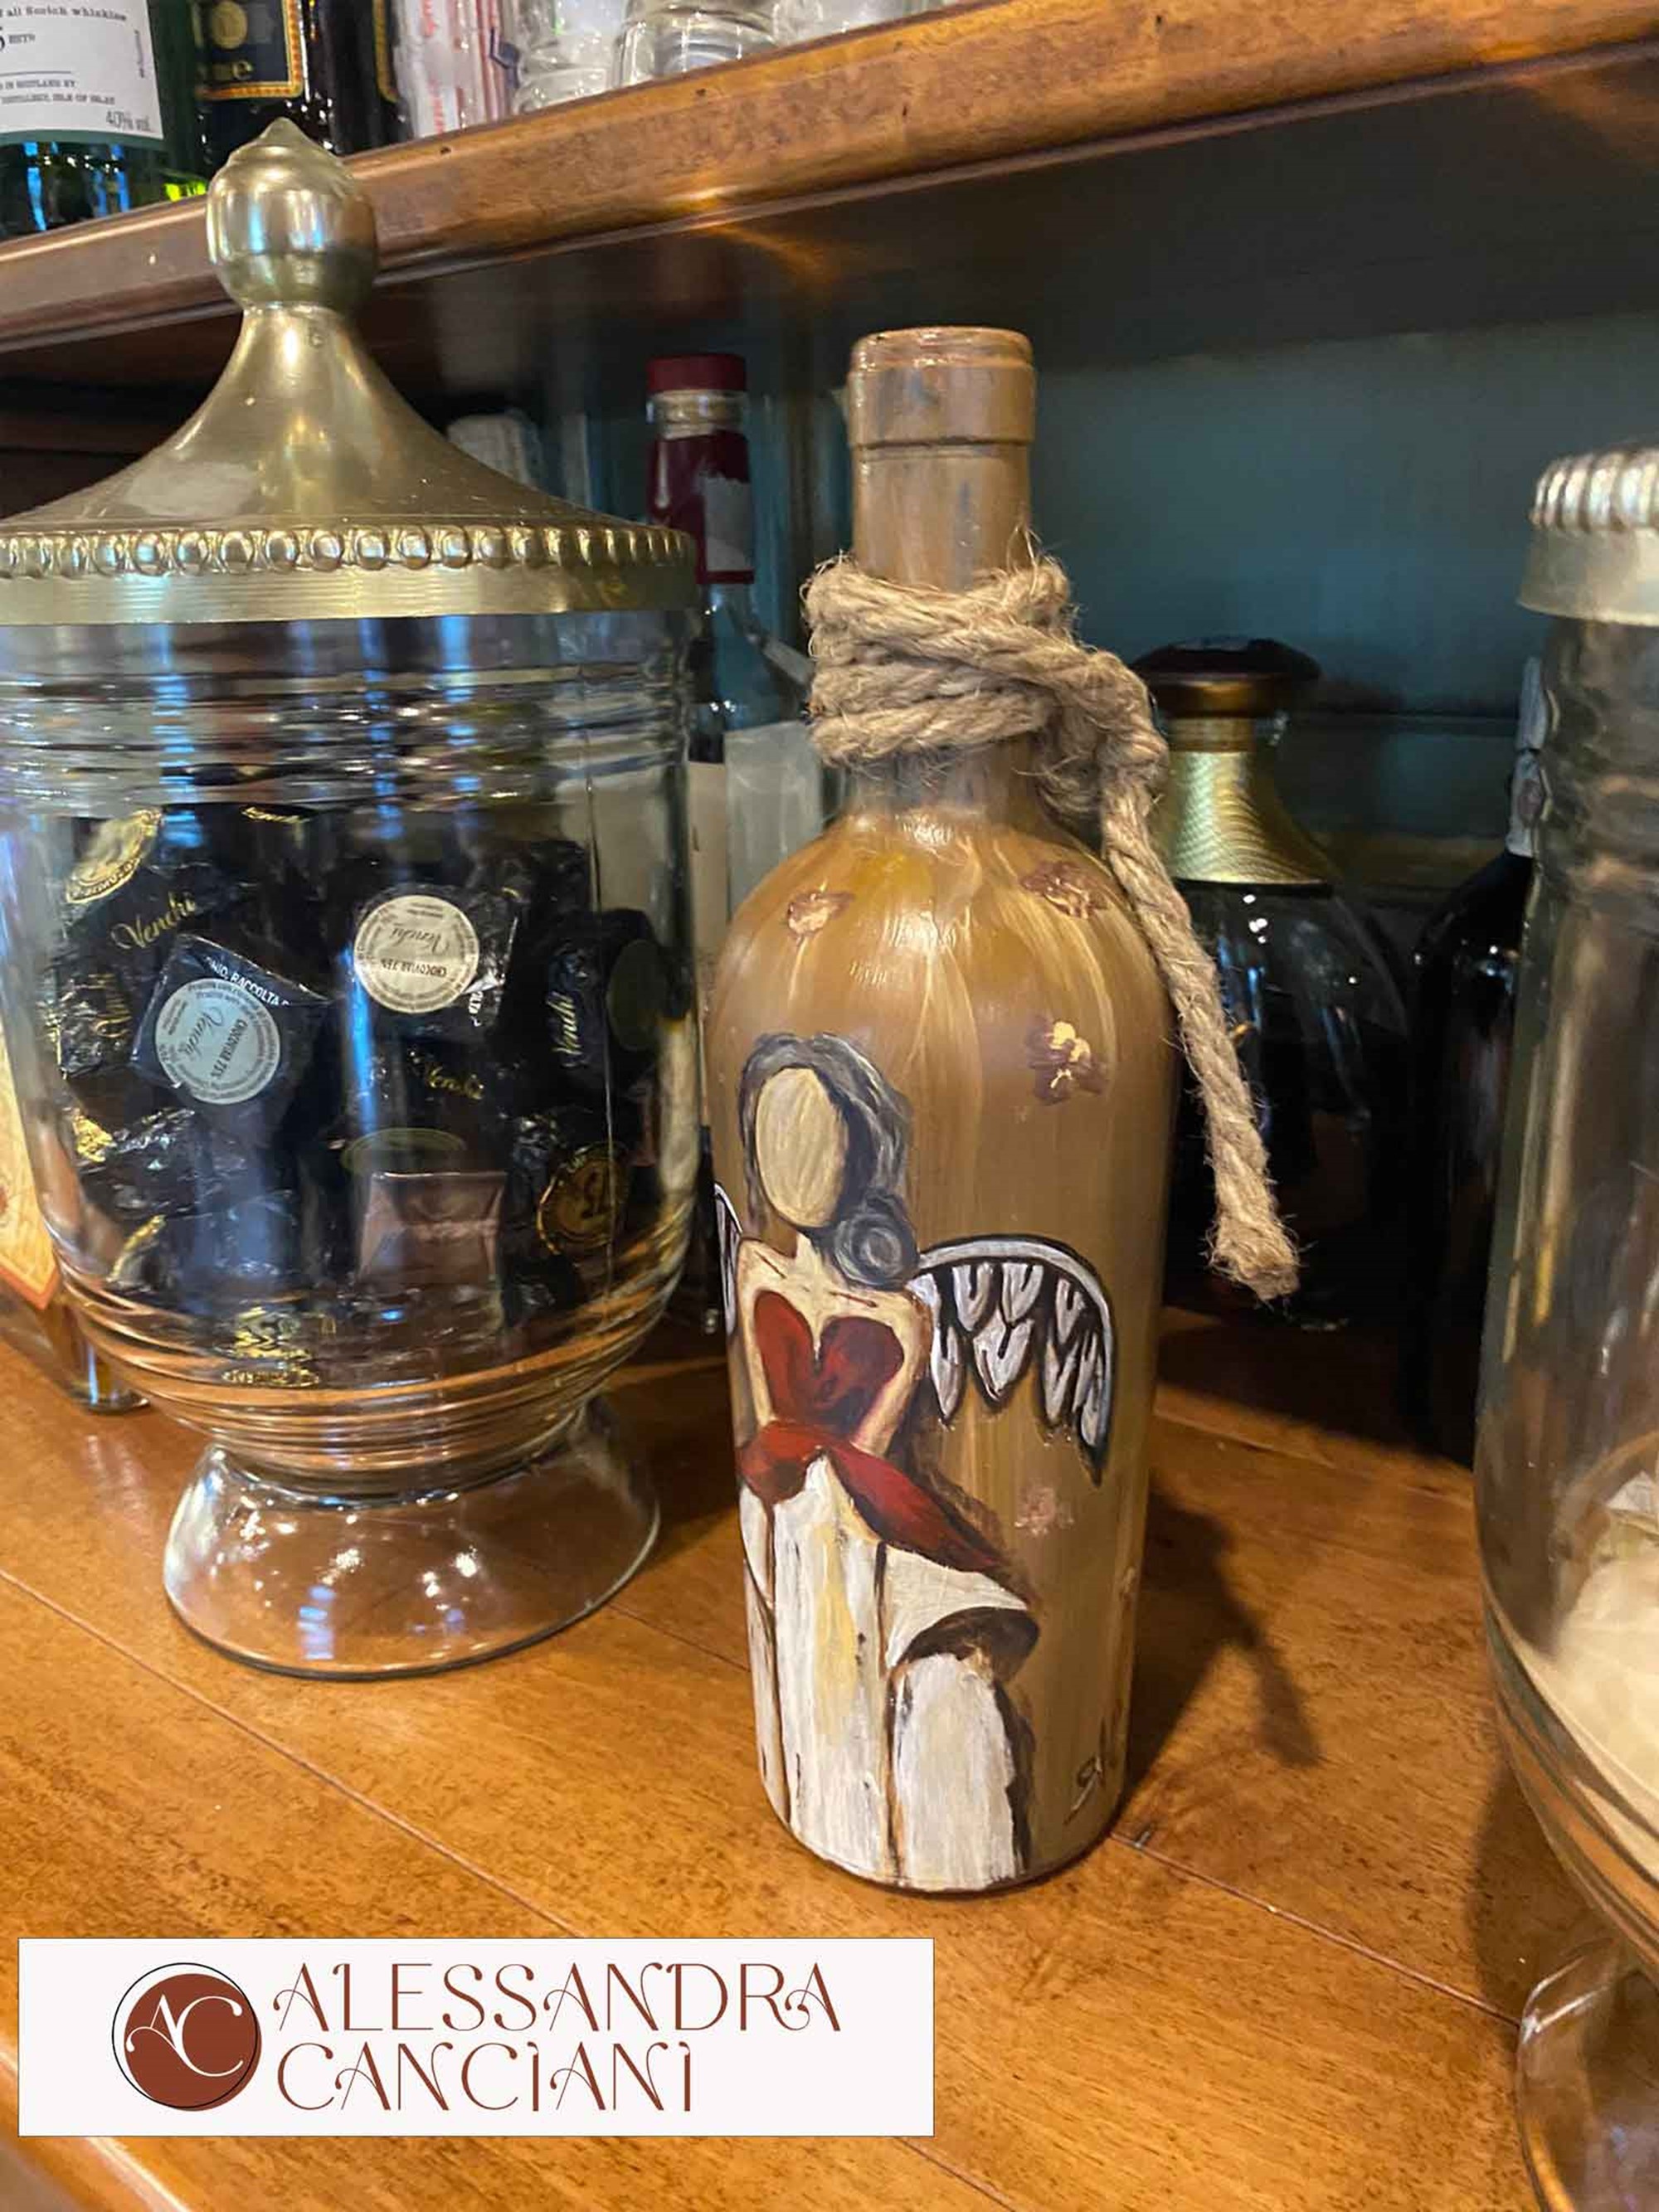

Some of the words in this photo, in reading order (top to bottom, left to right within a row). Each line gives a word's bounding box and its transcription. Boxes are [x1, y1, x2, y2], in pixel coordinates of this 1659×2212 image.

[109, 892, 197, 950] Venchi
[388, 926, 450, 954] Venchi
[230, 972, 280, 1007] RACCOLTA
